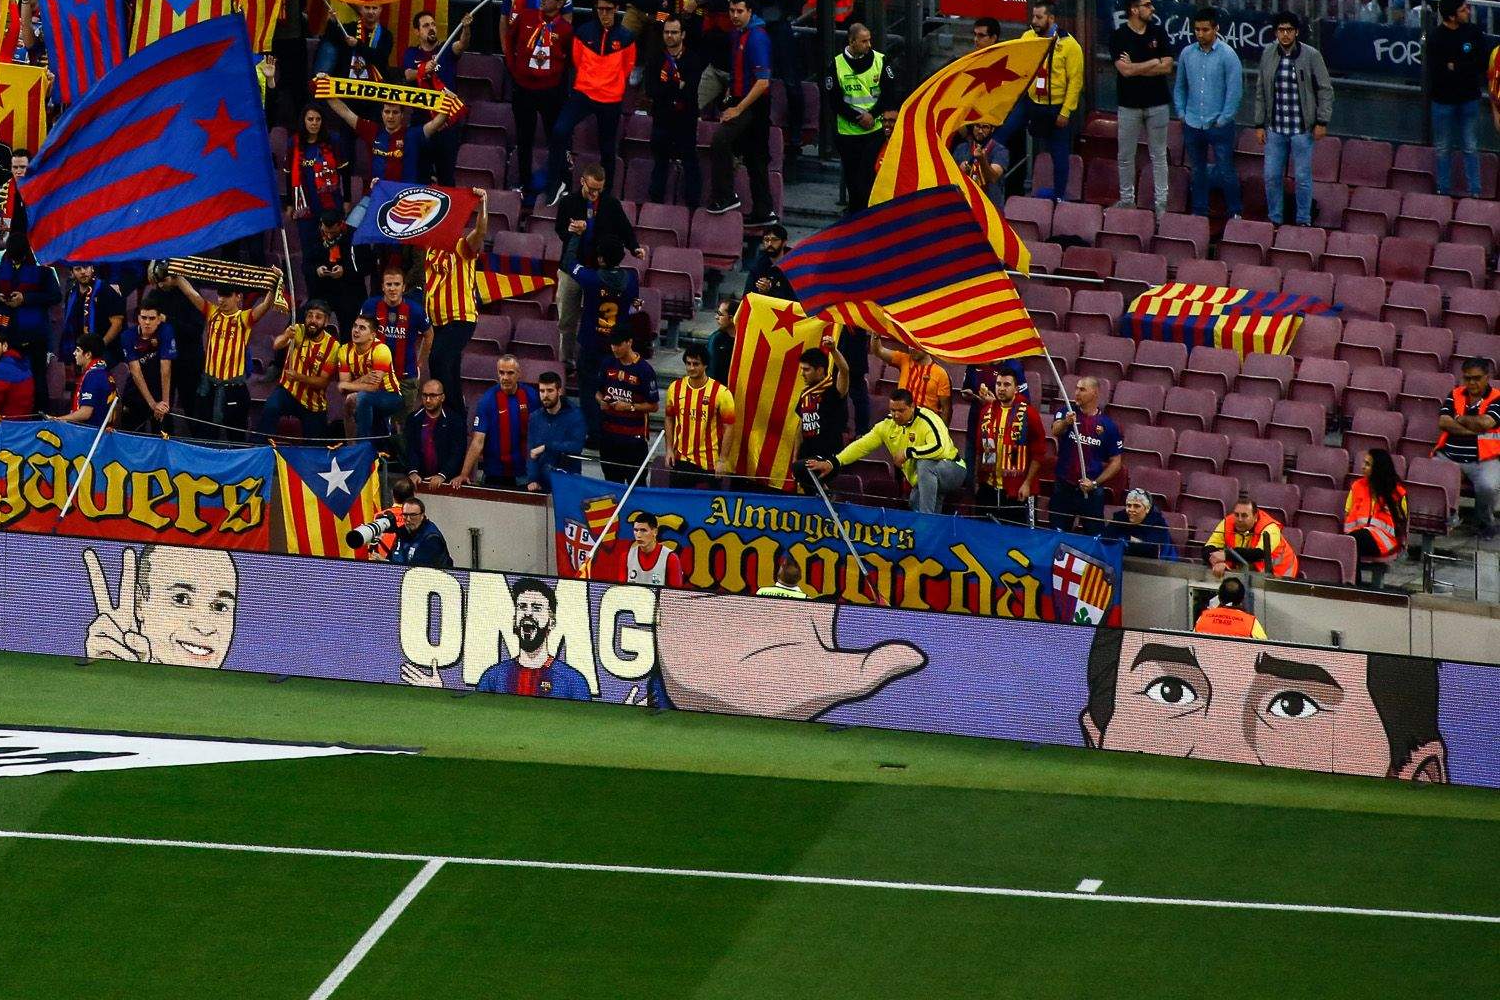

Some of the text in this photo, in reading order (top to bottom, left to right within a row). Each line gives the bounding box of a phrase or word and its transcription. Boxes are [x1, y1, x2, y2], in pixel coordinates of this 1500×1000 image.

[334, 80, 440, 108] LLIBERTAT
[378, 325, 406, 336] QATAR
[607, 386, 633, 399] QATAR
[400, 566, 656, 695] OMG
